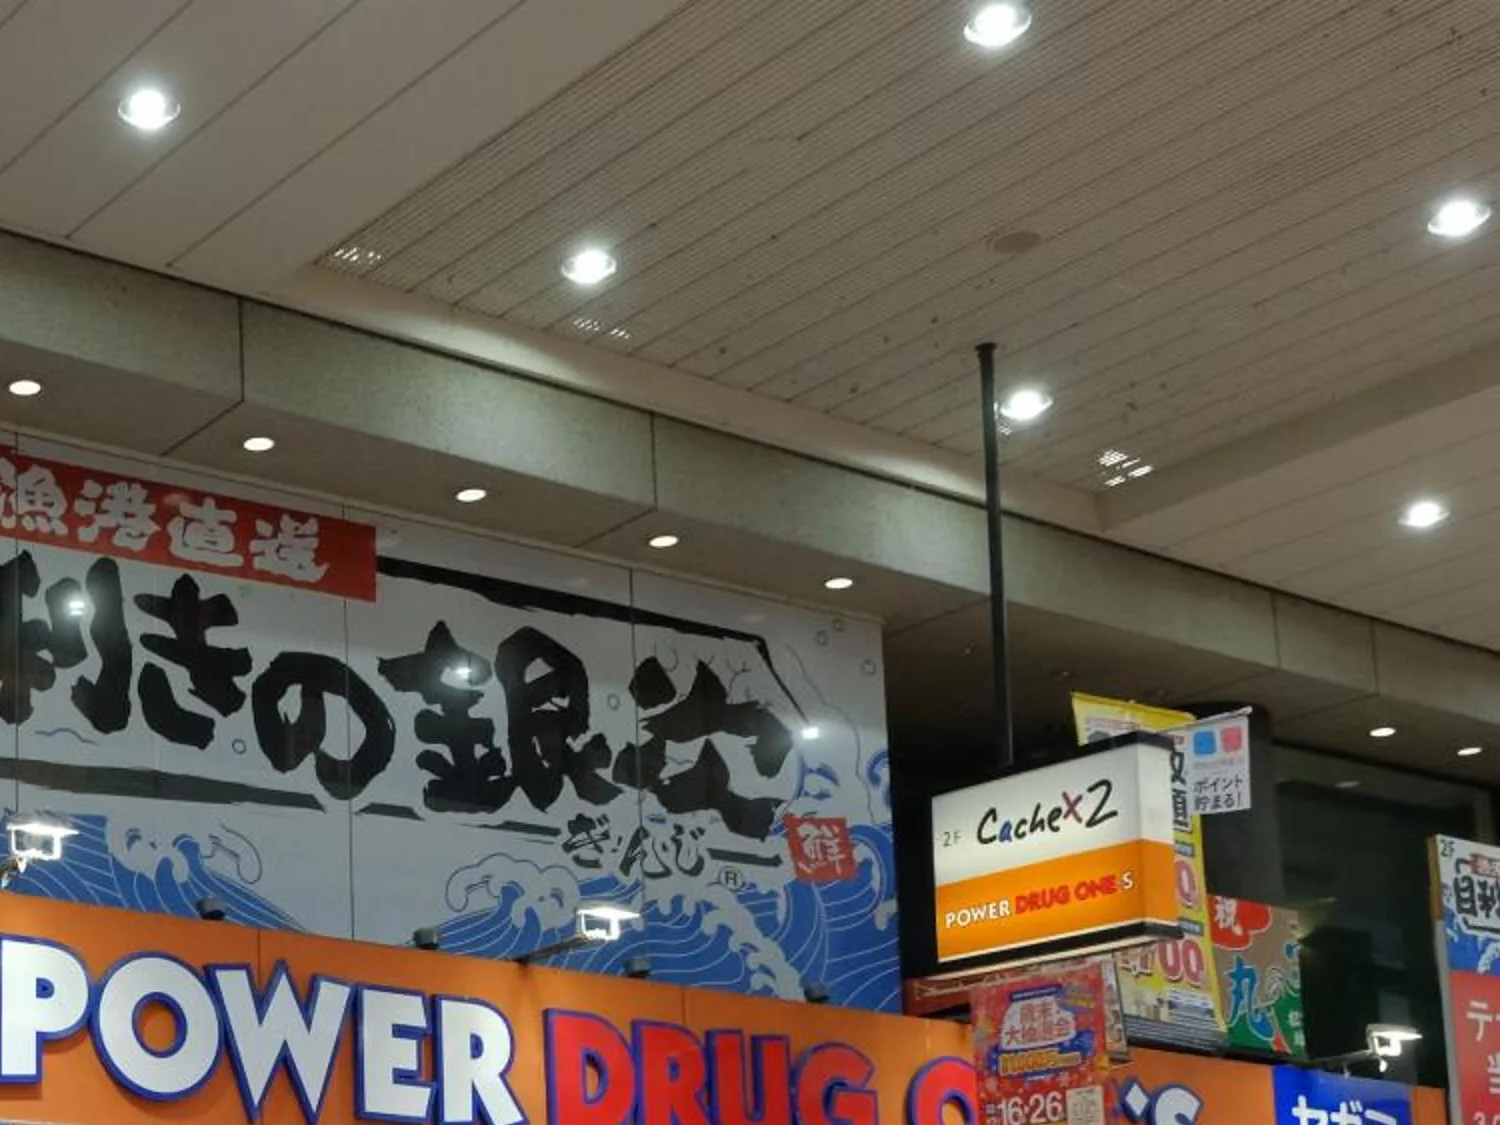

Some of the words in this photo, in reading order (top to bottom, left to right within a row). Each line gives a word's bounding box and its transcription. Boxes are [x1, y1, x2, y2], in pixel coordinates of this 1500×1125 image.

[563, 812, 706, 879] ぎんじ
[944, 899, 1011, 929] POWER
[1014, 884, 1071, 914] DRUG
